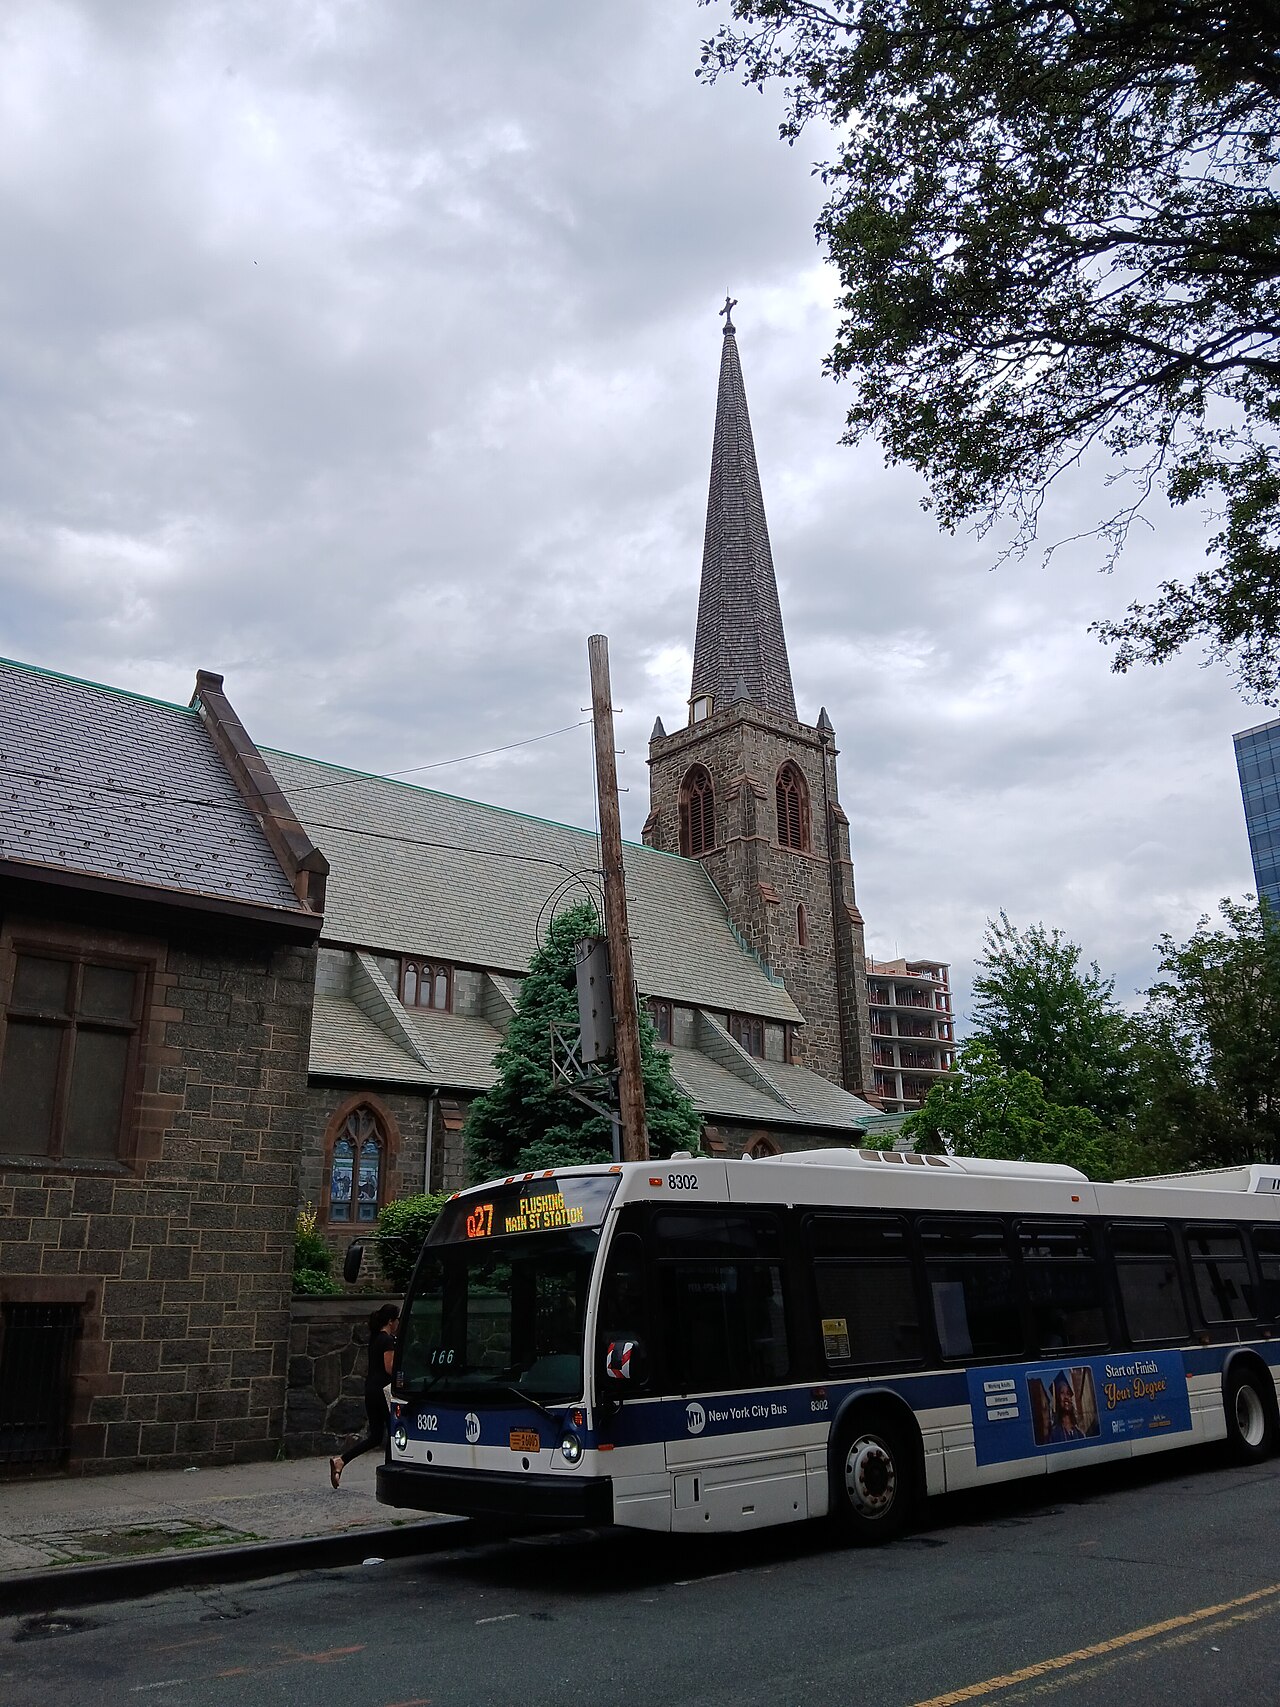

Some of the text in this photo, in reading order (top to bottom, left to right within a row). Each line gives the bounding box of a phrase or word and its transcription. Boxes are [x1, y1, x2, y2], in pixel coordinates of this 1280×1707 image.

[667, 1174, 699, 1190] 8302
[519, 1192, 565, 1215] FLUSHING
[466, 1203, 494, 1238] Q27
[505, 1206, 584, 1232] MAIN ST STATION
[1105, 1360, 1158, 1378] Start or Finish
[1104, 1377, 1166, 1409] Your Degree
[708, 1403, 788, 1422] New York City Bus
[810, 1400, 829, 1412] 8302
[417, 1414, 438, 1431] 8302
